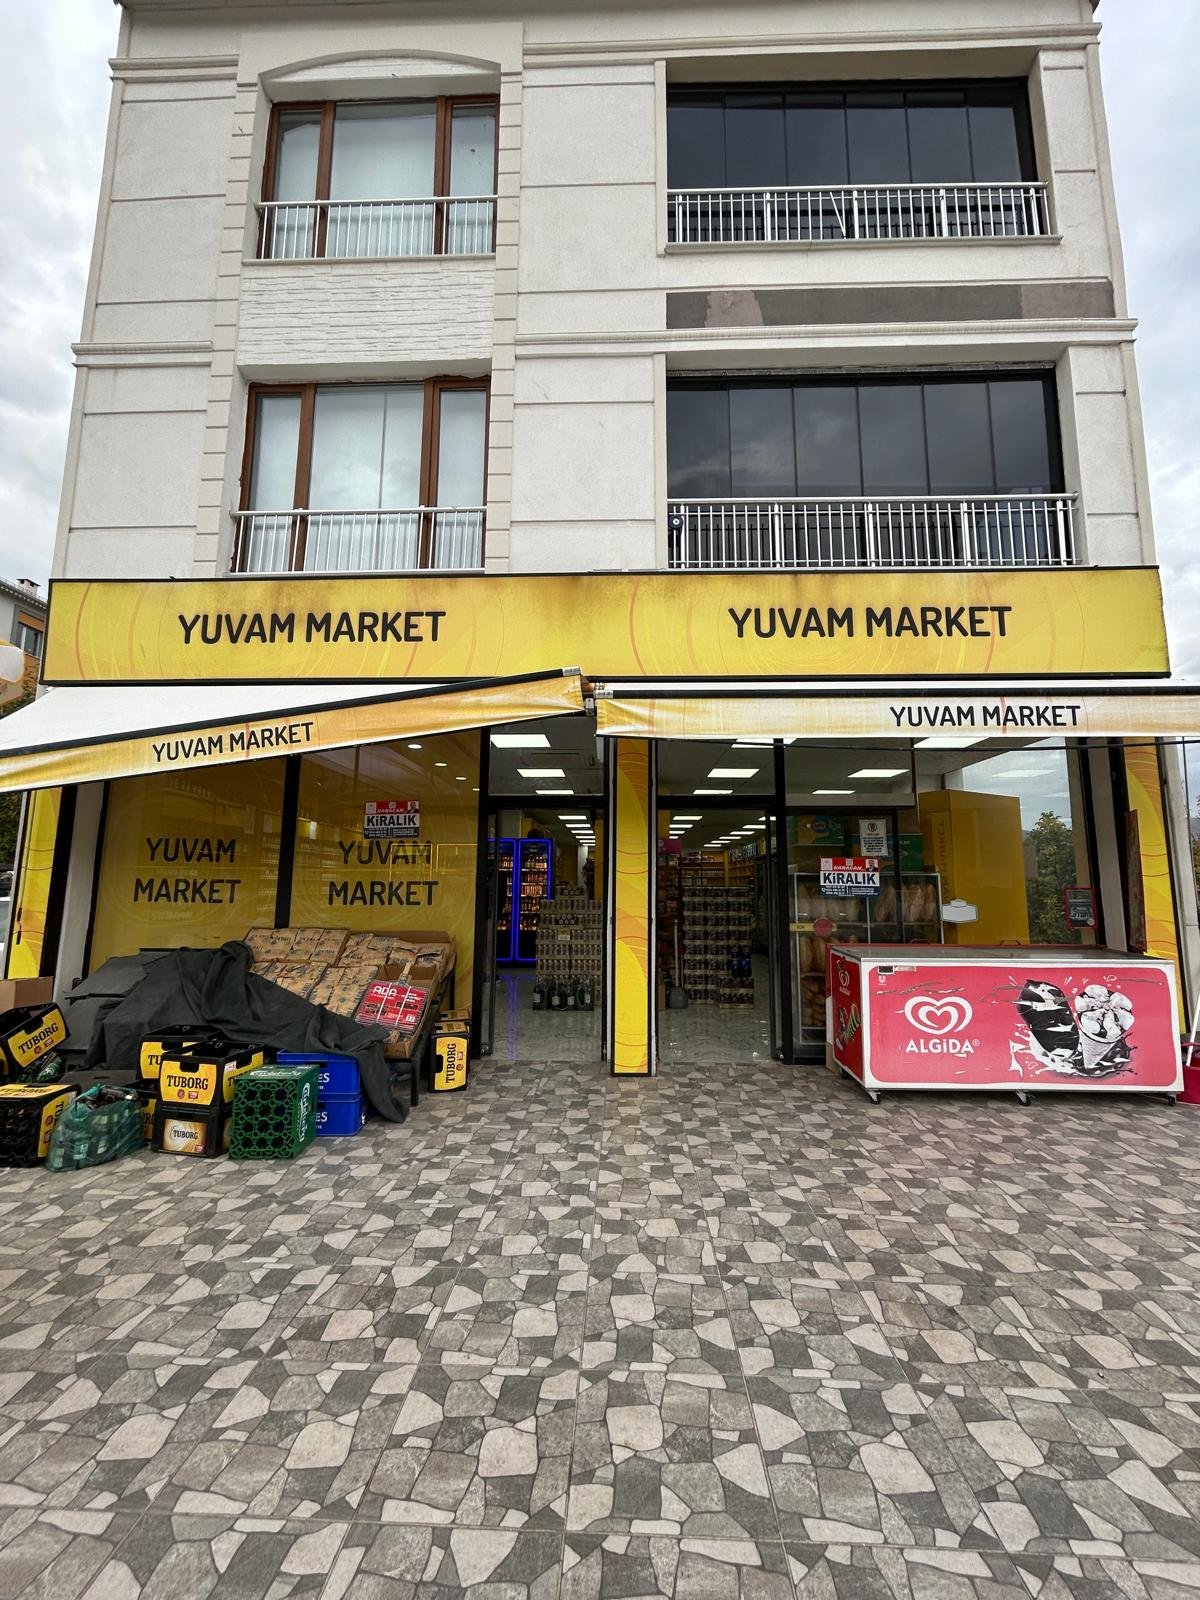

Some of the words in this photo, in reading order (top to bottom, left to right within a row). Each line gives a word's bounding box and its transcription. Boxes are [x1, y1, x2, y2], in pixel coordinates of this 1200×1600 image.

[178, 613, 295, 644] YUVAM
[305, 611, 447, 642] MARKET
[728, 607, 854, 638] YUVAM
[865, 606, 1012, 637] MARKET
[890, 705, 975, 727] YUVAM
[982, 705, 1080, 726] MARKET
[152, 734, 223, 762] YUVAM
[229, 721, 314, 753] MARKET
[146, 838, 236, 864] YUVAM
[338, 840, 432, 865] YUVAM
[133, 878, 242, 904] MARKET
[328, 880, 439, 906] MARKET
[373, 985, 397, 997] ADA
[18, 1022, 59, 1055] TUBORG
[446, 1043, 456, 1084] TUBORG
[167, 1075, 209, 1090] TUBORG
[173, 1130, 198, 1140] TUBORG
